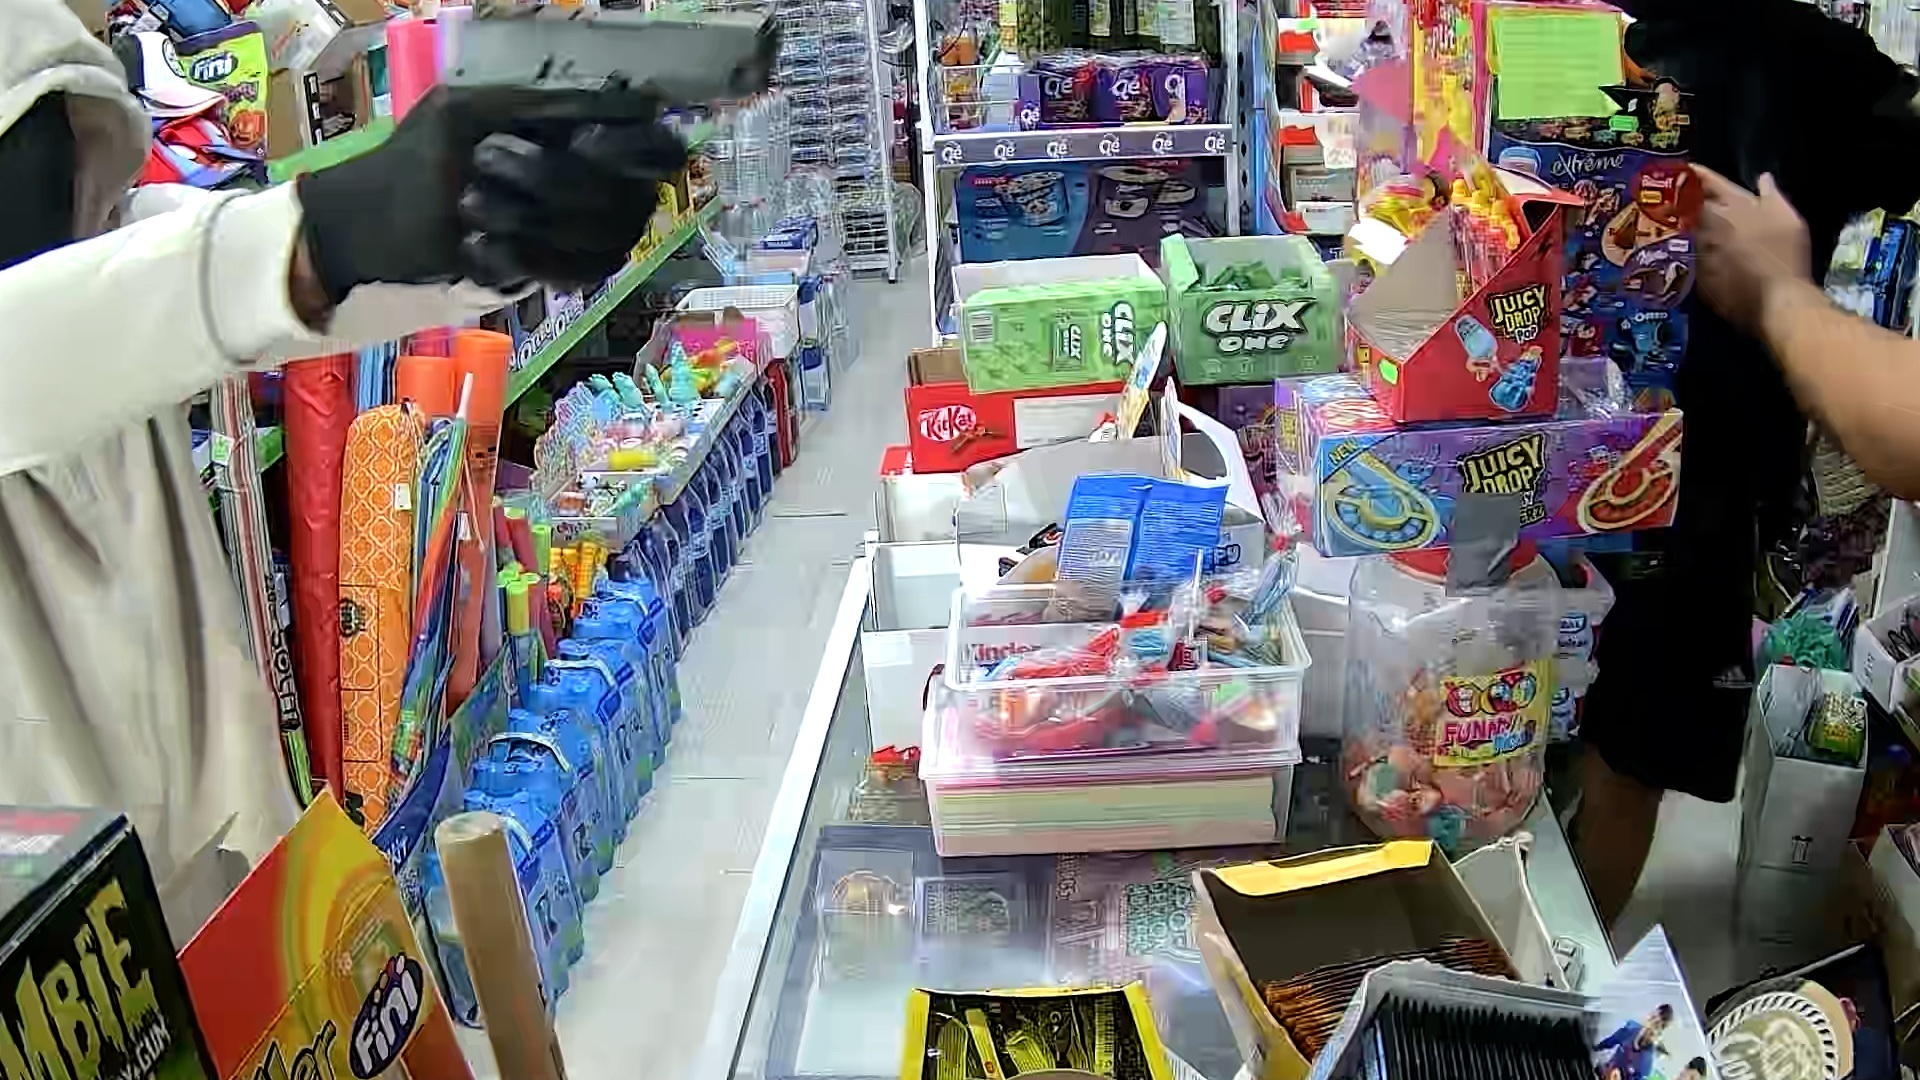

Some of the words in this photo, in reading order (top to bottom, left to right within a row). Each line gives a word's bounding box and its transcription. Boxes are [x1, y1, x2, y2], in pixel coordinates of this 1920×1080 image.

[1492, 286, 1546, 323] JUICY
[1504, 306, 1541, 332] DROP
[1515, 325, 1538, 343] POP
[1328, 437, 1359, 465] NEW
[1465, 435, 1542, 492] JUICY
[1482, 466, 1534, 494] DROP
[135, 1012, 173, 1073] GUM
